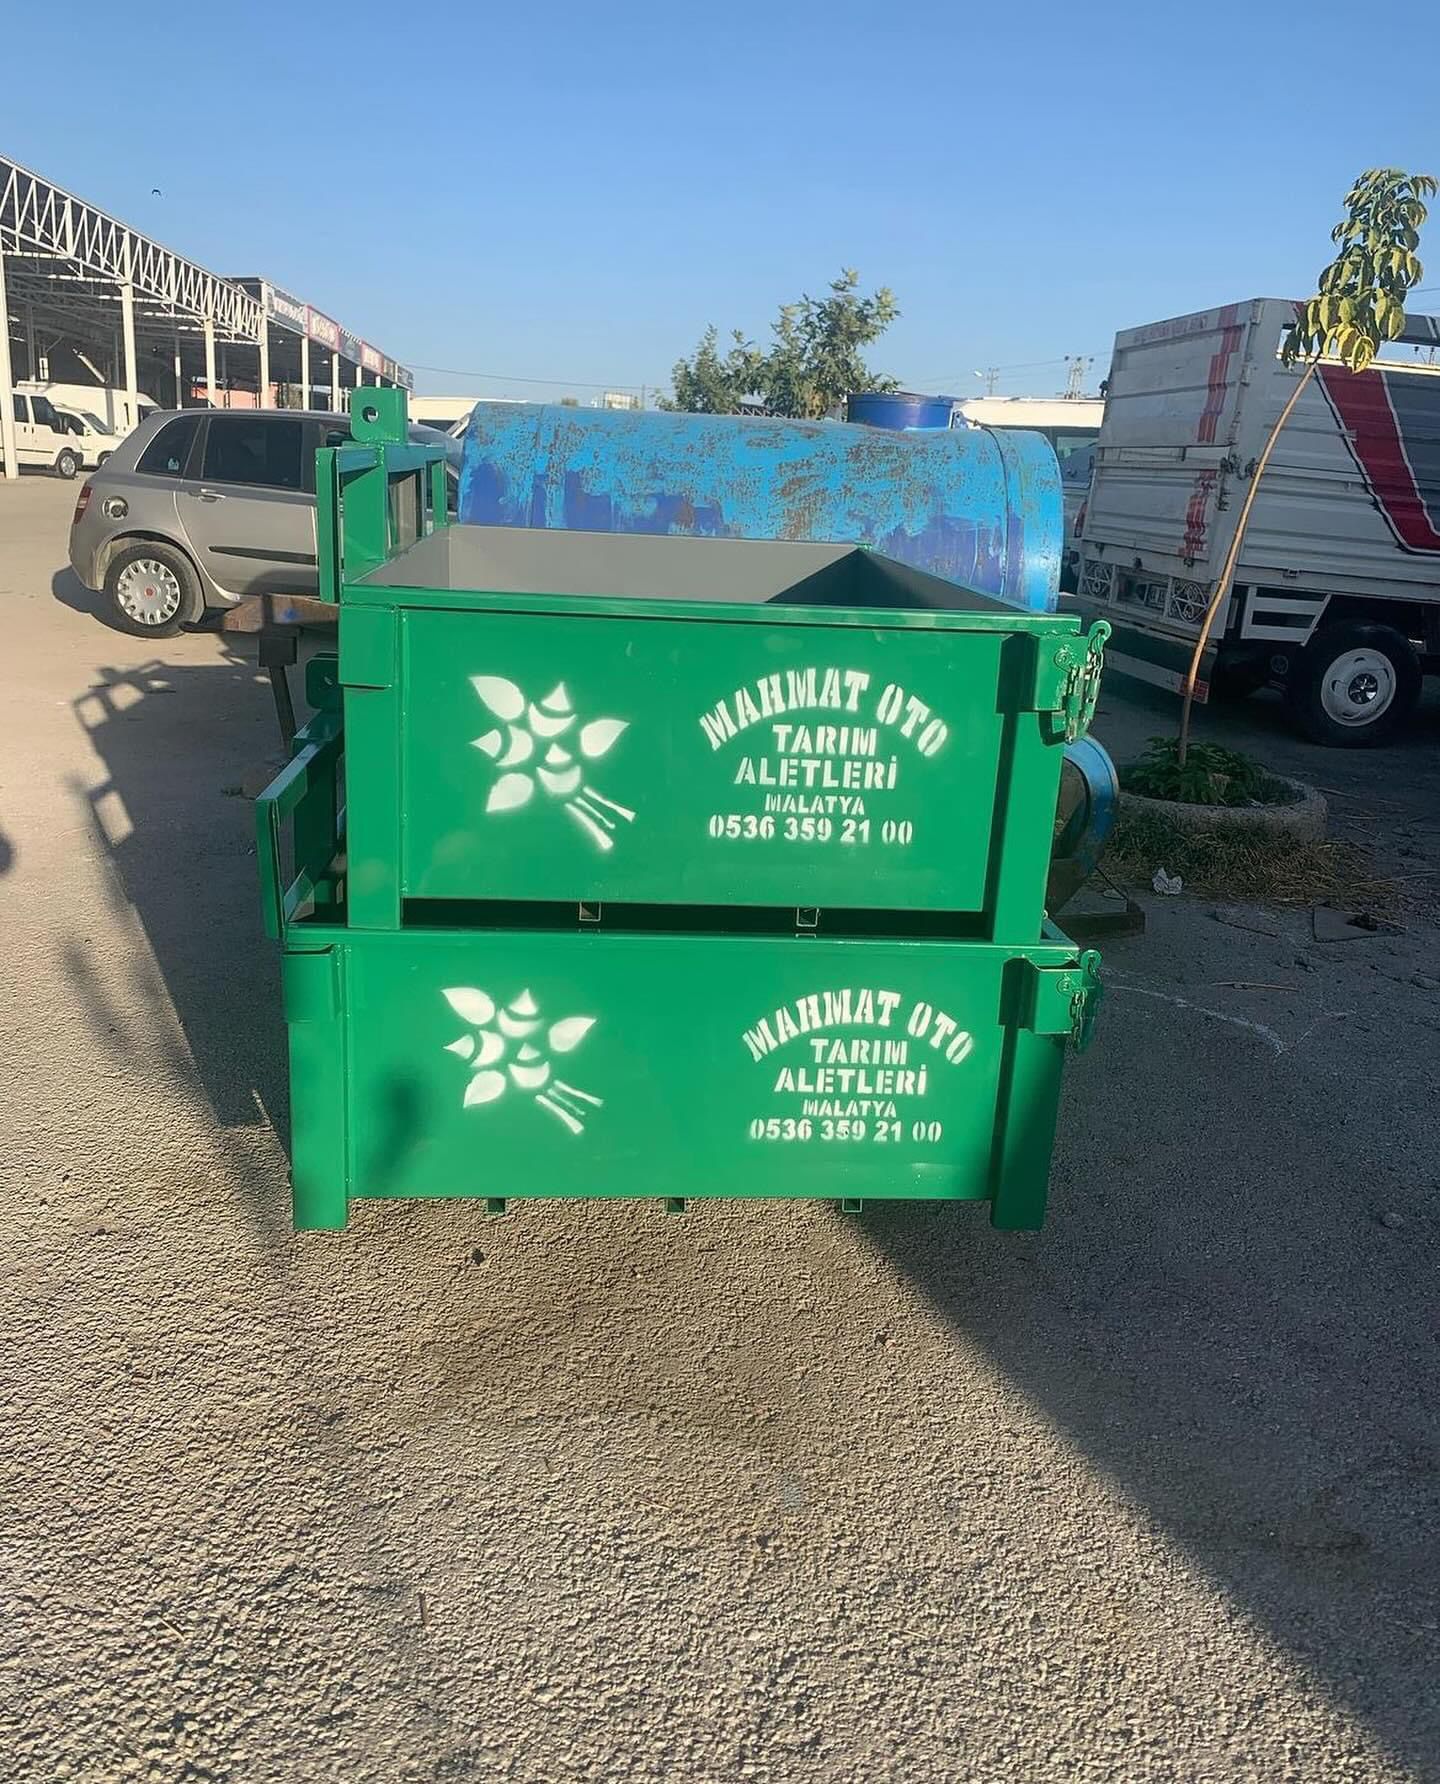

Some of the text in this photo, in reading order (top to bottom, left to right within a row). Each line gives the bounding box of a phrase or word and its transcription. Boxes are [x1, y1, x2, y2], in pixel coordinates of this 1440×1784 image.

[699, 668, 948, 757] MAHMAT OTO
[772, 724, 877, 756] TARIM
[734, 755, 897, 790] ALETLERİ
[764, 793, 865, 816] MALATYA
[709, 814, 913, 845] 0536 359 21 00
[742, 989, 973, 1065] MAHMAT OTO
[810, 1038, 908, 1065] TARIM
[774, 1063, 928, 1096] ALETLERİ
[802, 1099, 897, 1118] MALATYA
[750, 1118, 943, 1142] 0536 359 21 00
